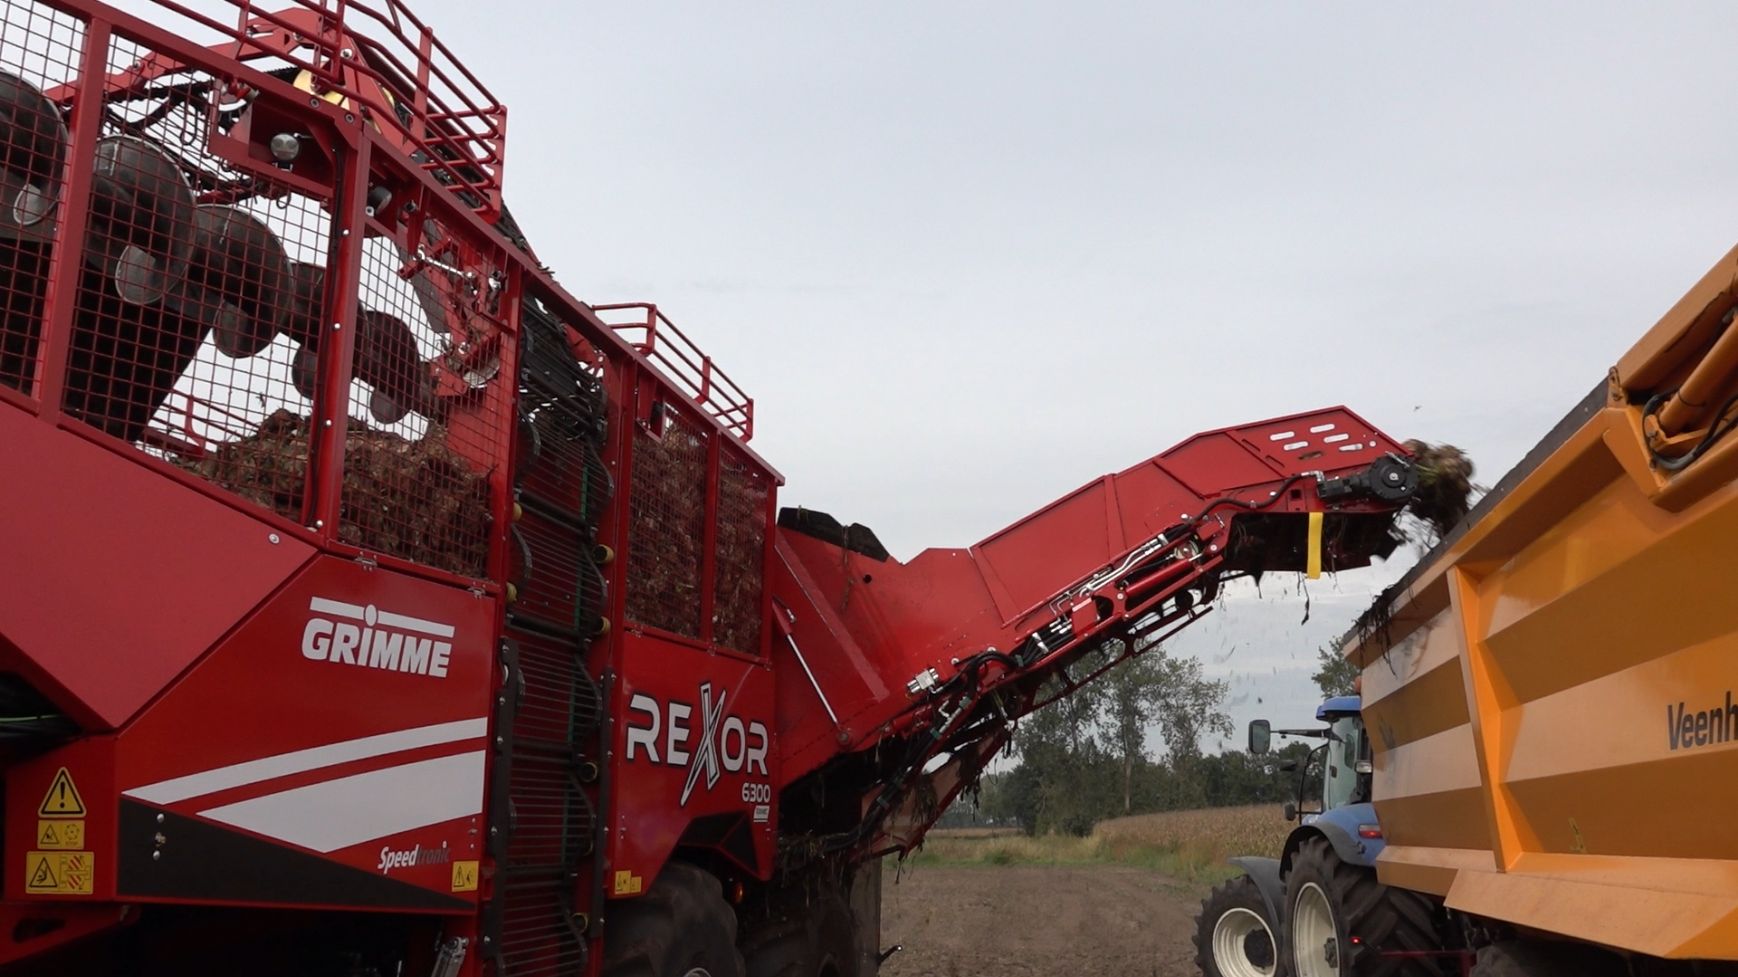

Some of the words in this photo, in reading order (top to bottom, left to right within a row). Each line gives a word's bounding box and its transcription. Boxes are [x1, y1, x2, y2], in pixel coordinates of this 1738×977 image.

[302, 607, 453, 677] GRIMME
[627, 683, 768, 806] REXOR
[741, 782, 771, 803] 6300
